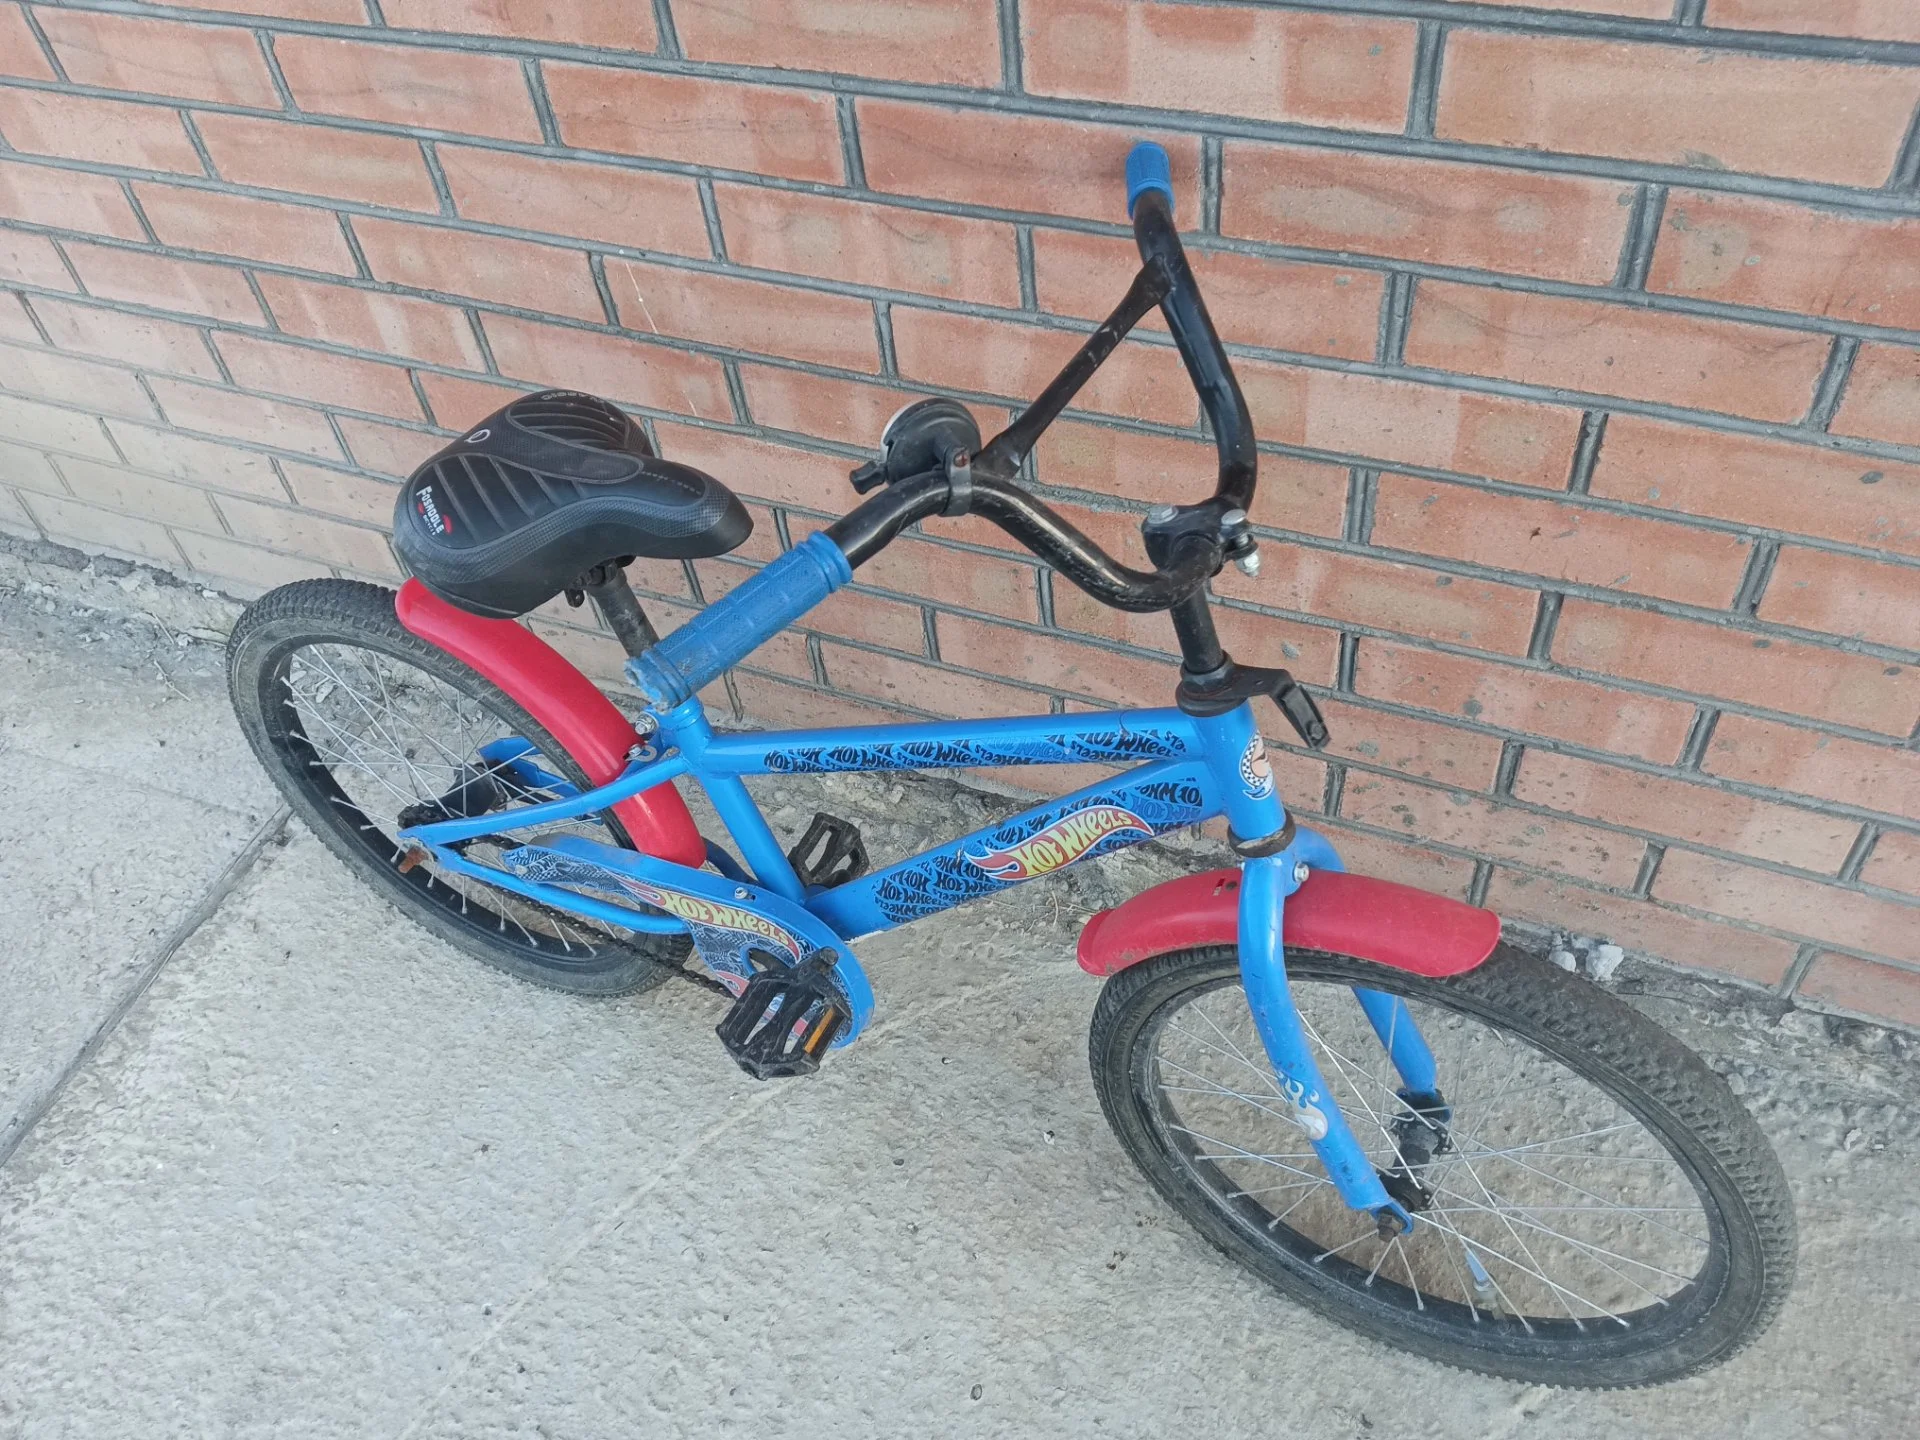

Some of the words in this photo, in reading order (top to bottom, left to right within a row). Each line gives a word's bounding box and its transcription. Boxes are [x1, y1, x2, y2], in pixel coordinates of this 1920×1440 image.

[416, 485, 445, 534] FOSADDLE
[1005, 841, 1064, 877] HOT
[1045, 810, 1133, 861] WHEELS
[655, 891, 711, 919] HOT
[707, 903, 789, 946] WHEELS
